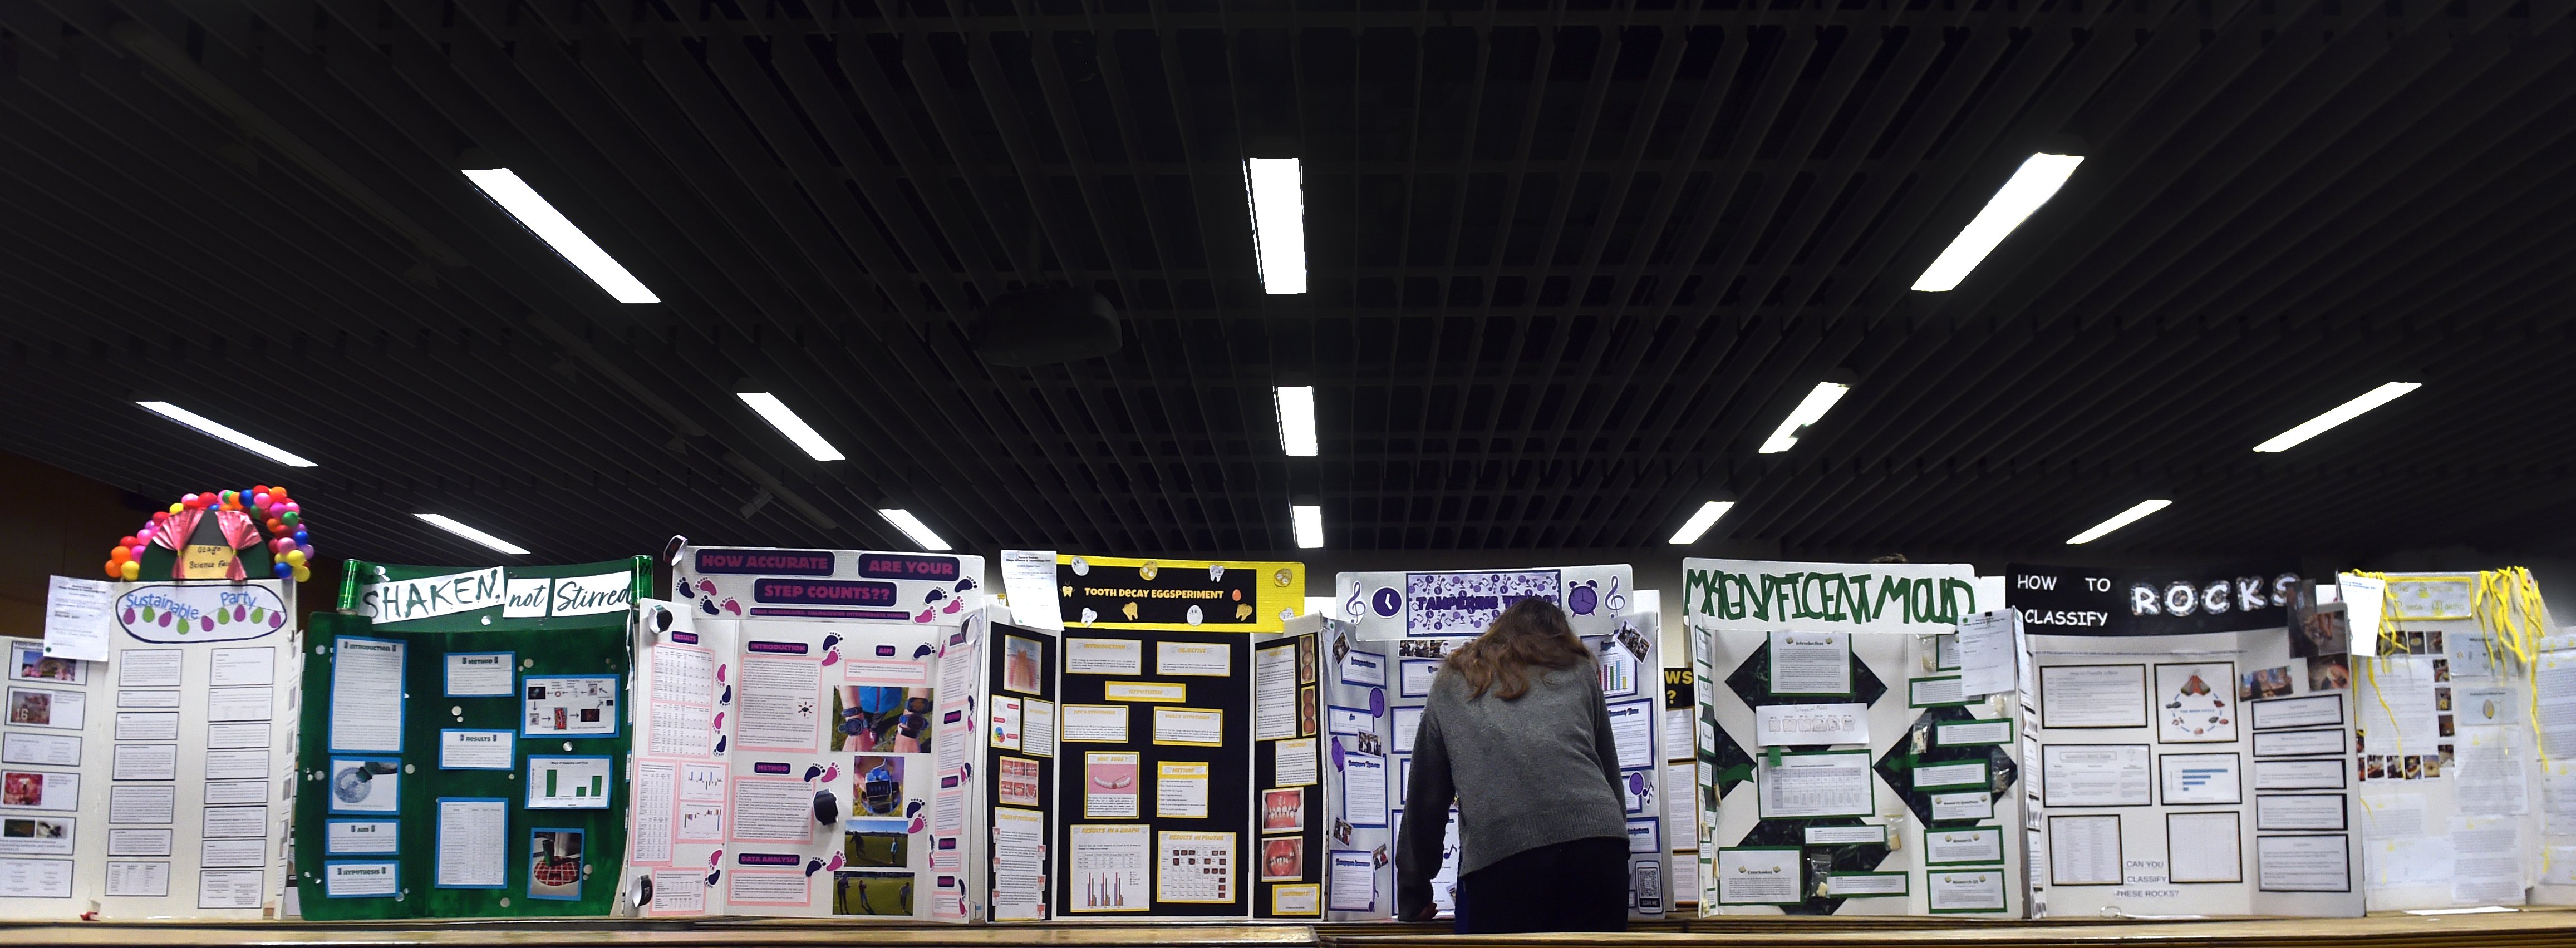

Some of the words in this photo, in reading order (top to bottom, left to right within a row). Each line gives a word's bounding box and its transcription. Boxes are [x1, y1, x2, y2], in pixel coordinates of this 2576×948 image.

[702, 555, 743, 567] HOW
[745, 556, 828, 570] ACCURATE
[868, 560, 902, 573] ARE
[906, 561, 953, 575] YOUR
[2018, 574, 2057, 590] HOW
[2085, 577, 2111, 592] TO
[363, 569, 500, 620] SHAKEN,
[509, 584, 547, 608] not
[557, 581, 632, 611] Stirred
[764, 585, 804, 598] STEP
[807, 586, 890, 600] COUNTS??
[1084, 587, 1117, 597] TOOTH
[1151, 589, 1224, 599] EGGSPERIMENT
[1683, 569, 1872, 624] MAGNIFICENT
[1872, 575, 1976, 625] MOULD
[2132, 572, 2299, 616] ROCKS
[125, 592, 199, 619] Sustainable
[220, 591, 257, 610] Party
[1415, 596, 1498, 610] TAMPERING
[2024, 609, 2108, 626] CLASSIFY
[1666, 690, 1677, 704] ?
[14, 708, 28, 721] 16
[2127, 875, 2167, 883] CLASSIFY
